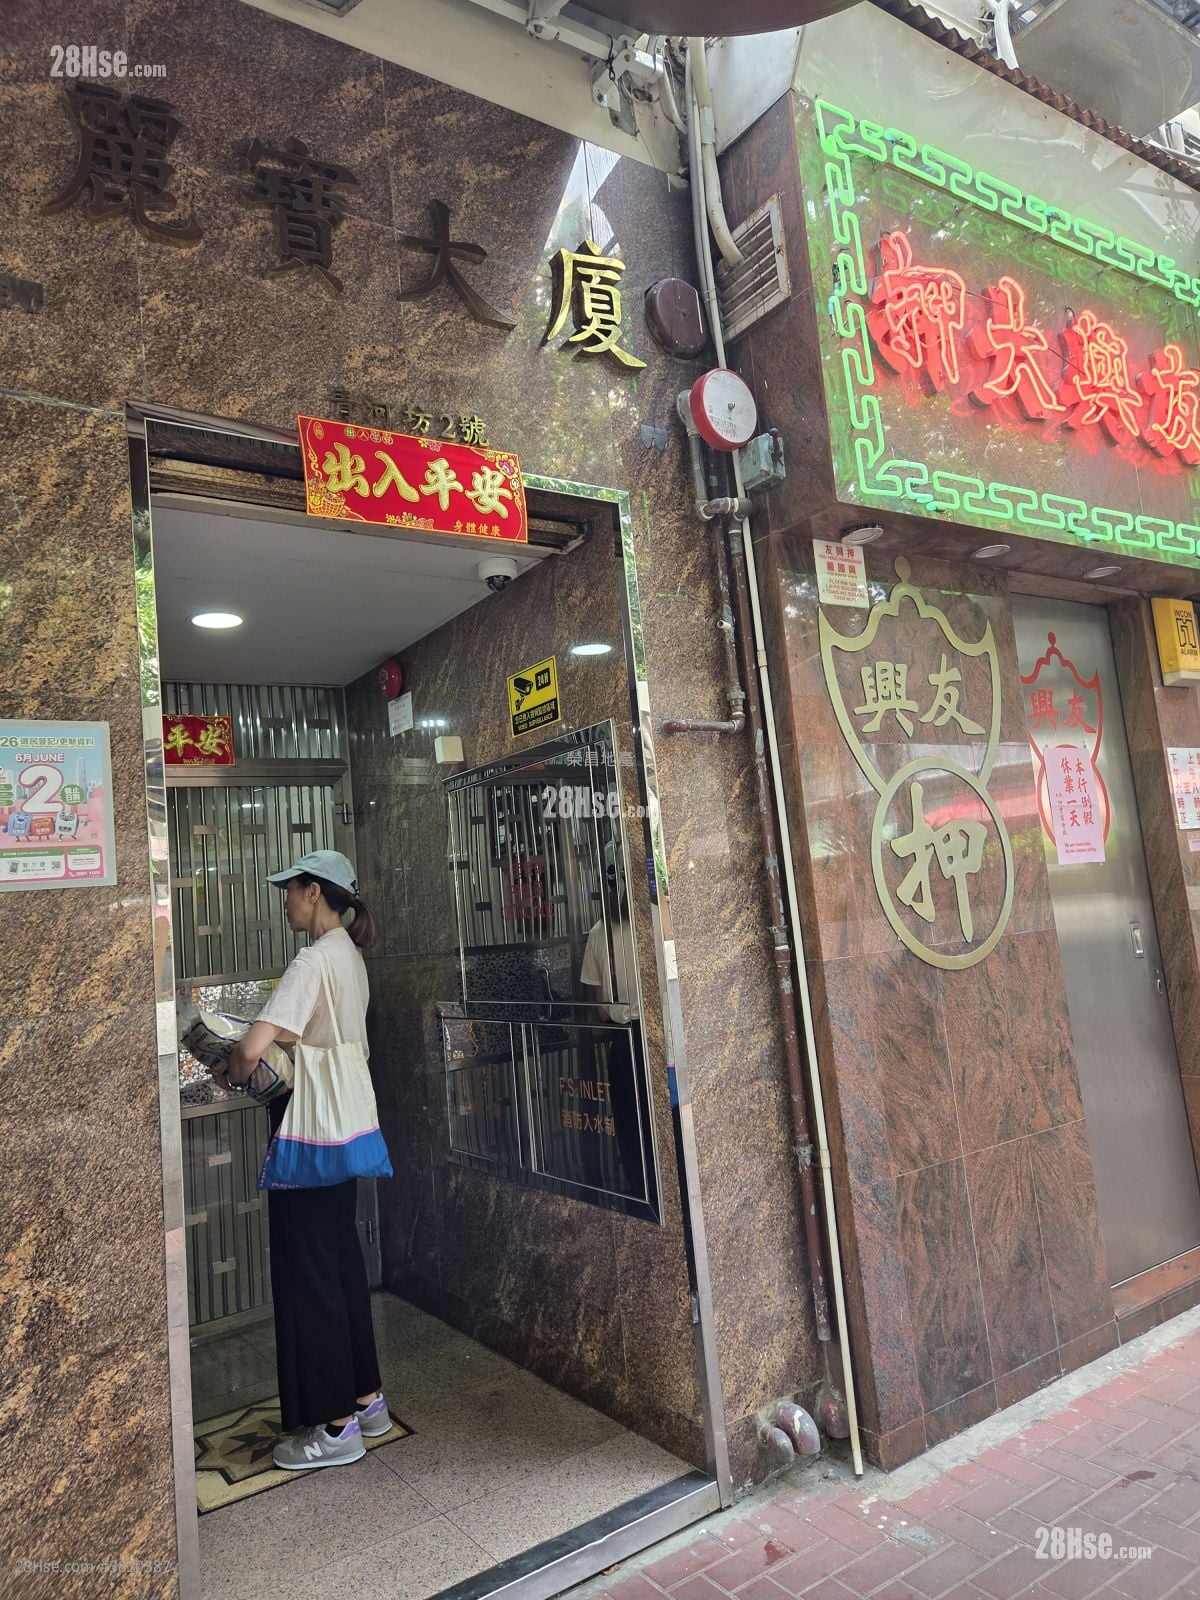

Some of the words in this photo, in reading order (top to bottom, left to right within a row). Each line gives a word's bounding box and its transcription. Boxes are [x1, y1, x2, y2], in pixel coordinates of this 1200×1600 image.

[42, 82, 648, 372] 麗寶大廈
[322, 442, 513, 519] 出入平安
[453, 519, 502, 537] 身體健康
[537, 672, 549, 687] 24H
[18, 763, 65, 813] 2
[1061, 757, 1081, 828] 休業一天
[890, 781, 988, 943] 押
[580, 1081, 611, 1103] INLET
[303, 1441, 323, 1461] N
